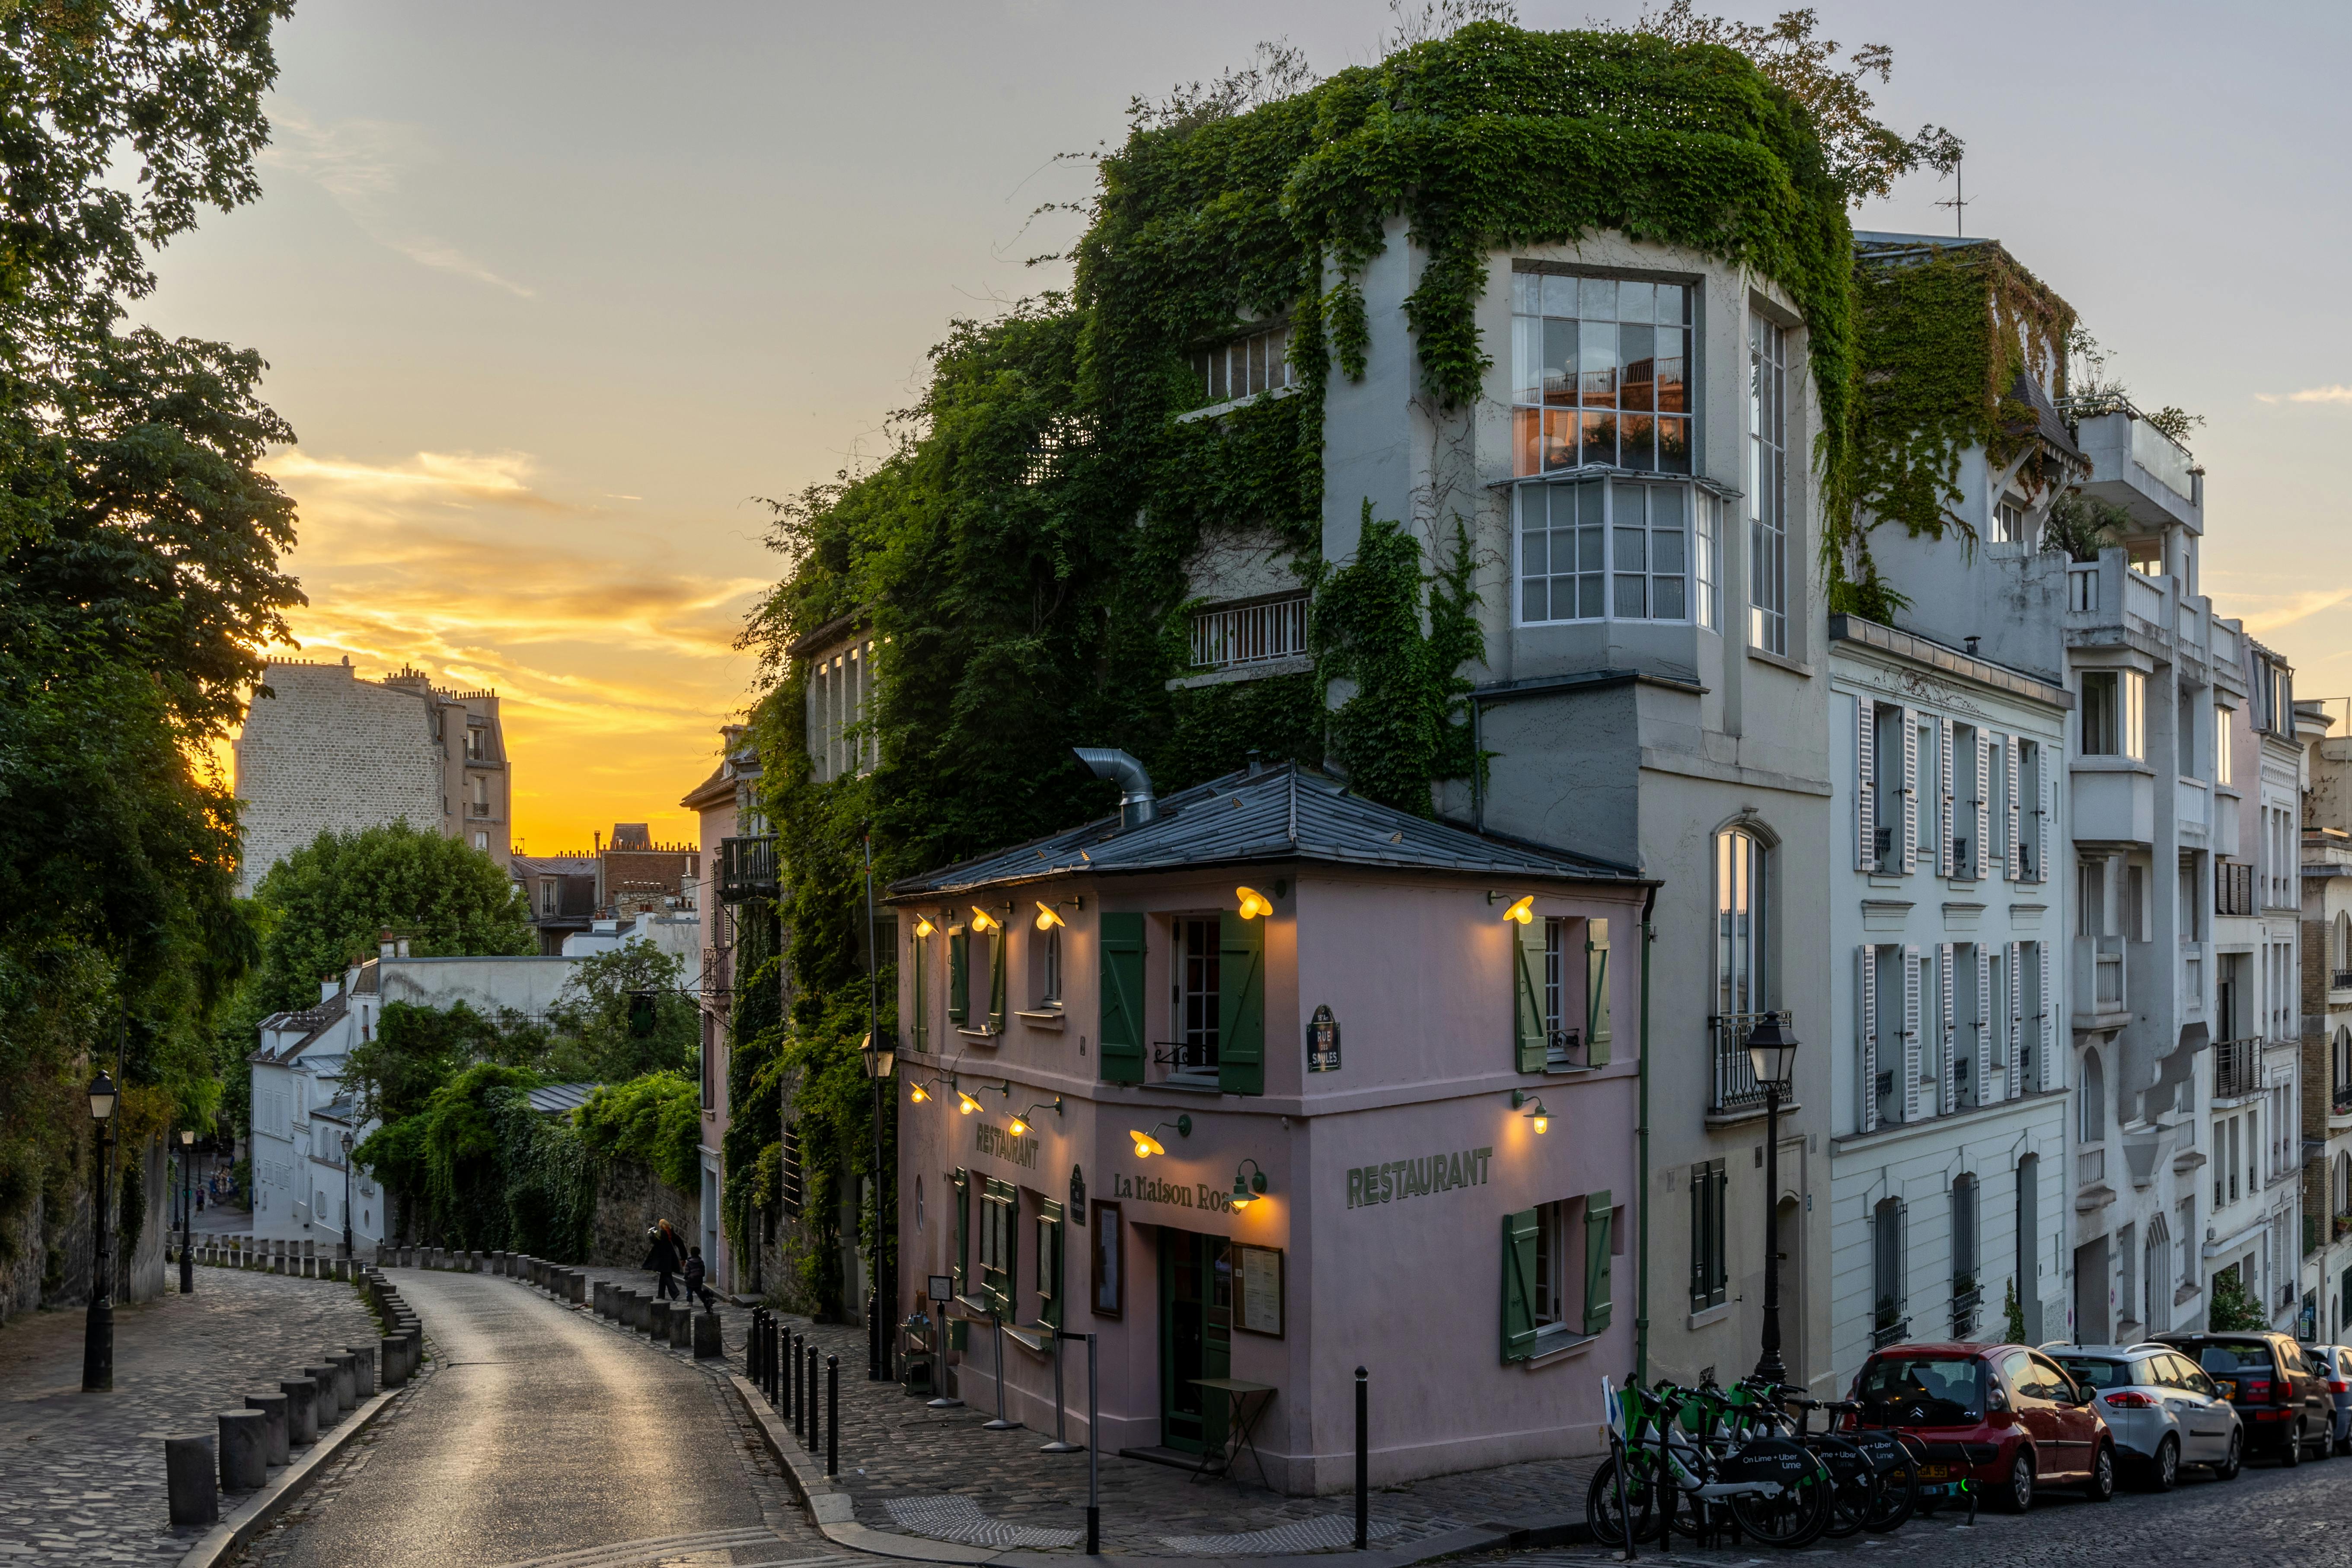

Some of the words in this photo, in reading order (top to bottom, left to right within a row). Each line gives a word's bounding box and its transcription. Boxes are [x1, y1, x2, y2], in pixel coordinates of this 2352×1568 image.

[1317, 1031, 1331, 1042] RUE
[1312, 1051, 1337, 1064] SAULES
[977, 1122, 1039, 1169] RESTAURANT
[1114, 1173, 1133, 1198] La
[1135, 1175, 1193, 1207] Maison
[1347, 1146, 1493, 1210] RESTAURANT
